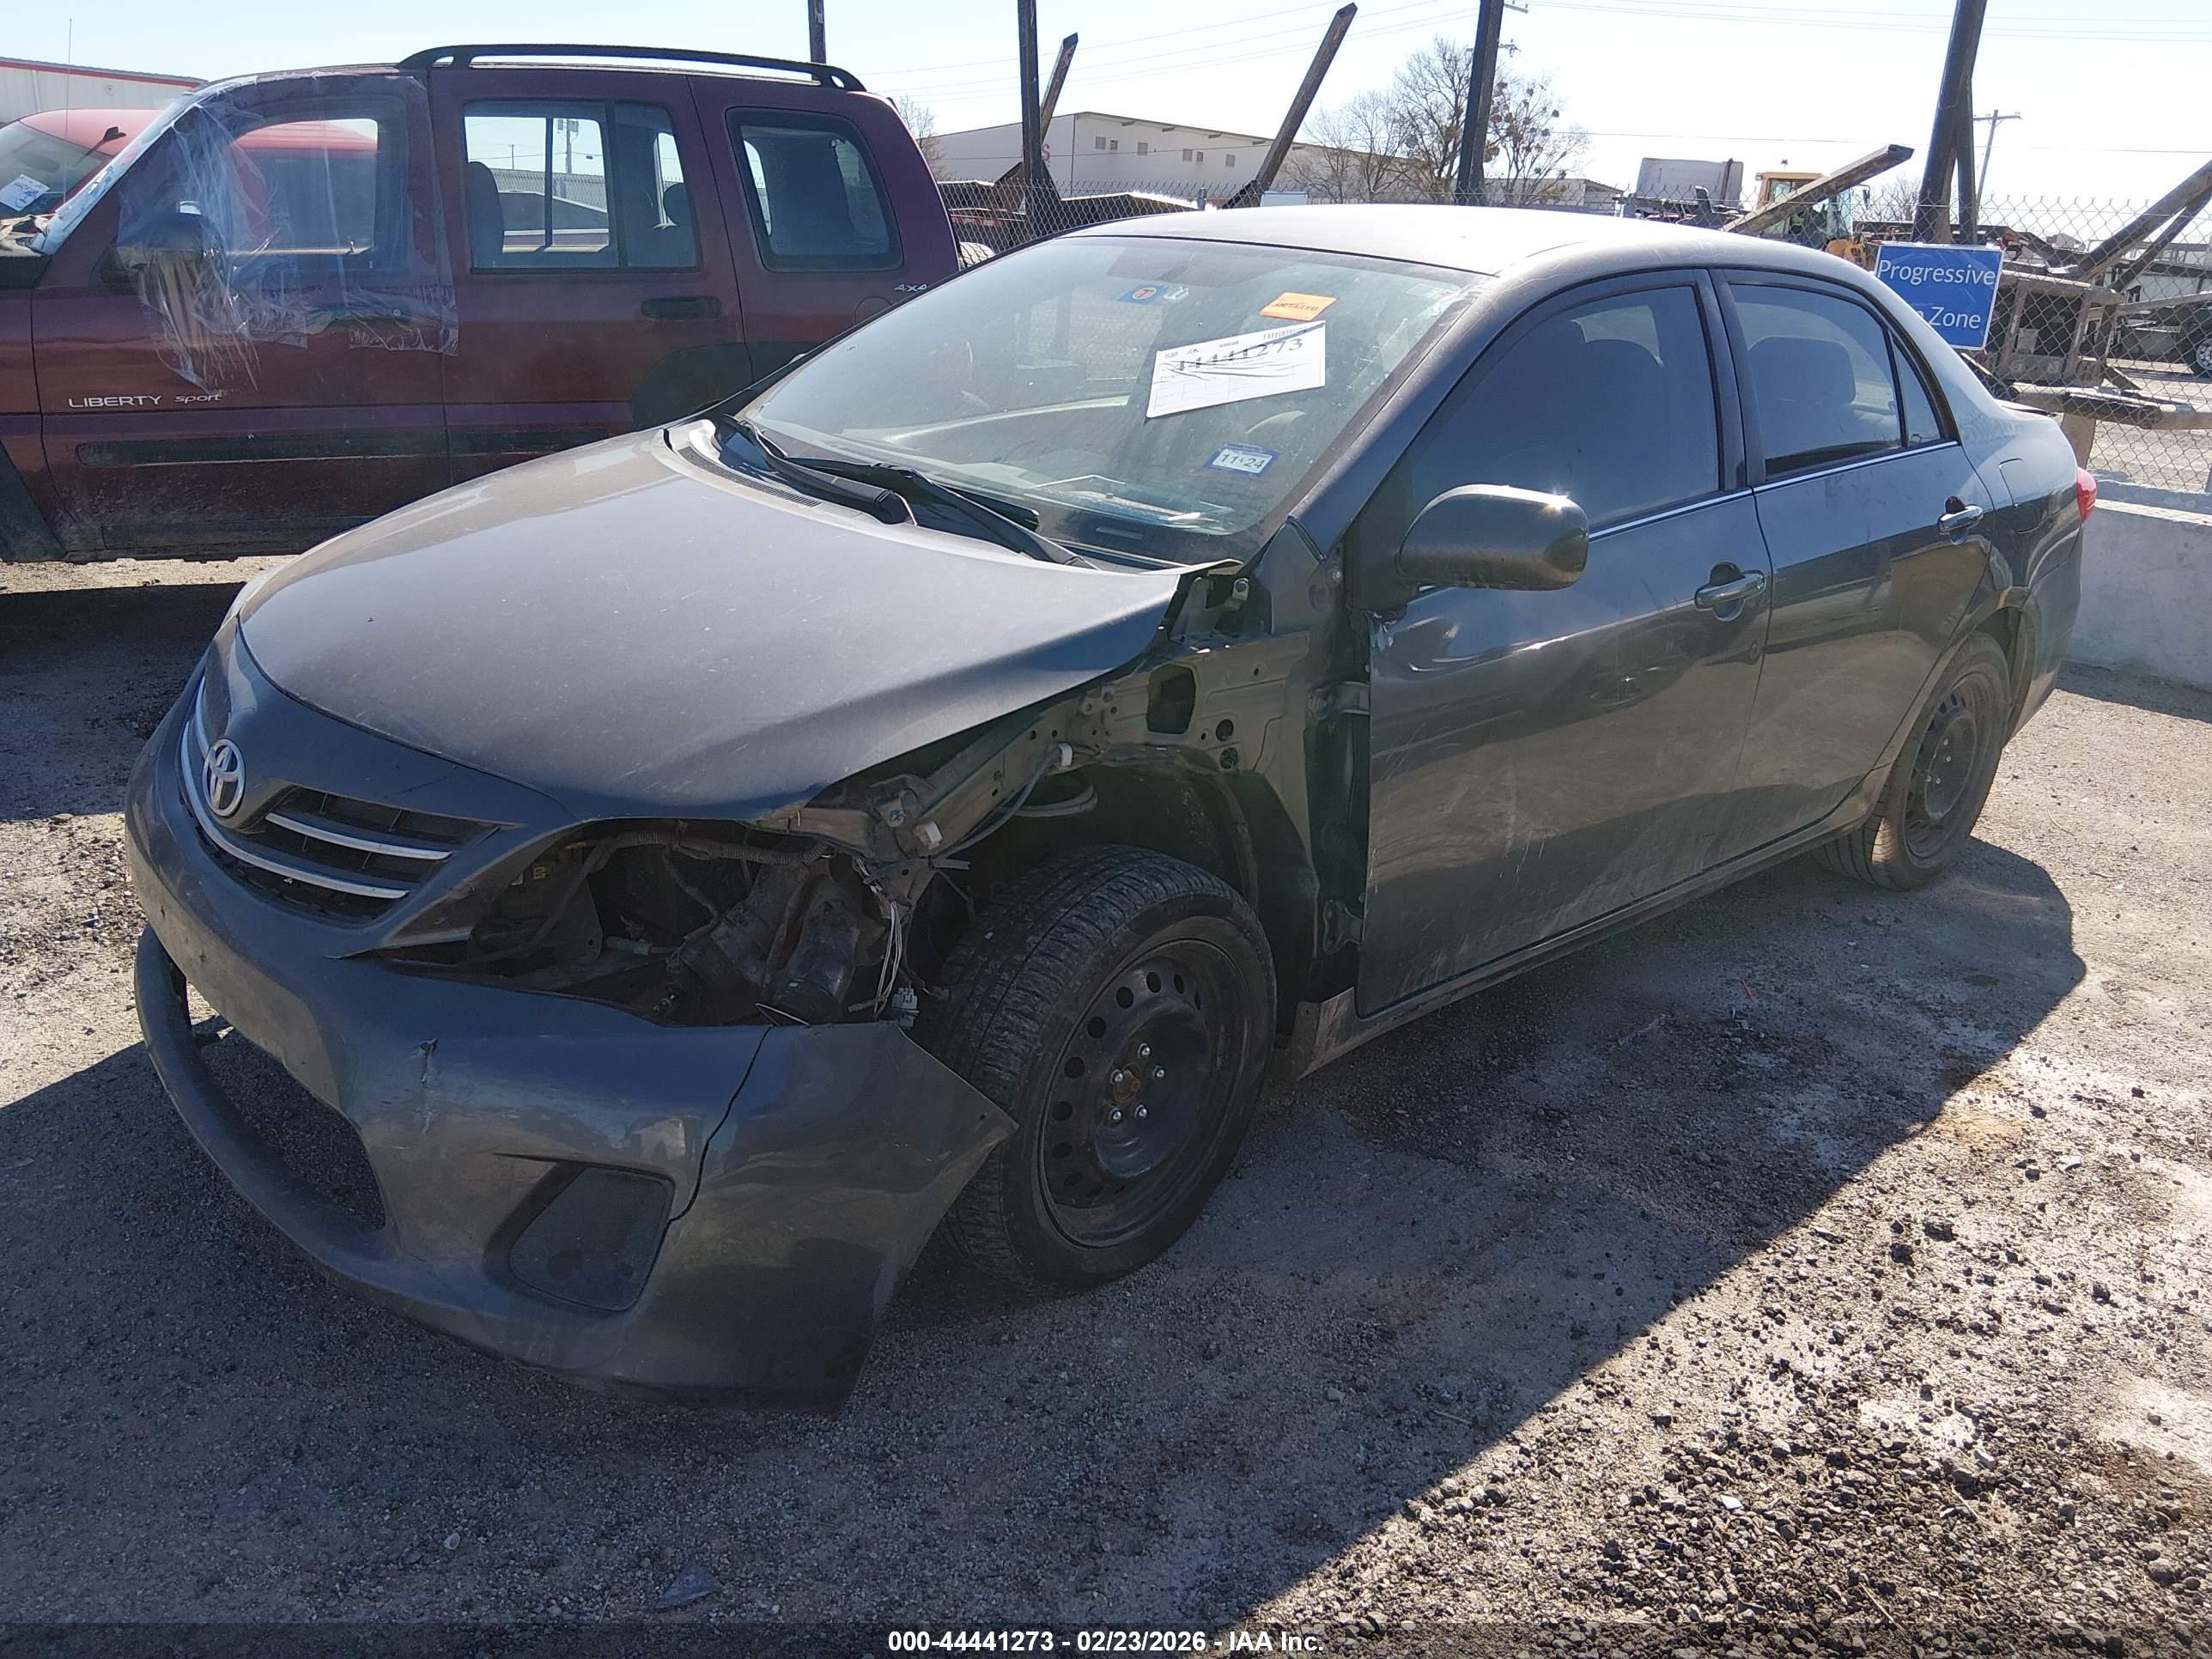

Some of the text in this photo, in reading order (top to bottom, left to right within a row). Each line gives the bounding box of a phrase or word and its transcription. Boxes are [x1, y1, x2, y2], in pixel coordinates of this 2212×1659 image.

[1877, 259, 1996, 286] Progressive
[1929, 306, 1981, 329] Zone
[68, 393, 222, 408] LIBERTY sport
